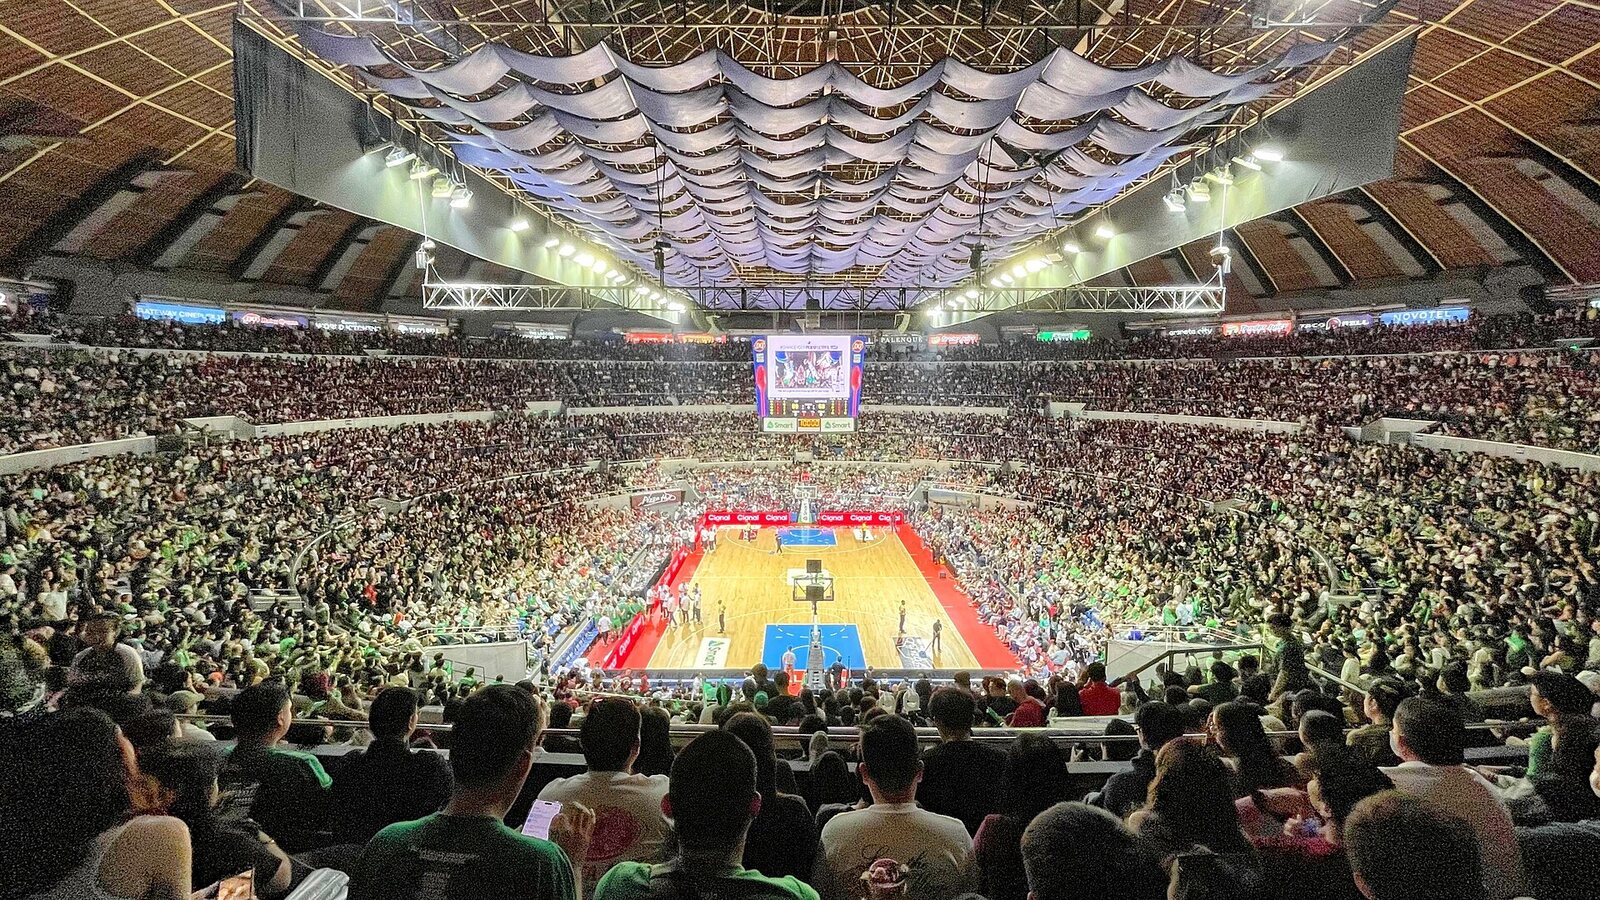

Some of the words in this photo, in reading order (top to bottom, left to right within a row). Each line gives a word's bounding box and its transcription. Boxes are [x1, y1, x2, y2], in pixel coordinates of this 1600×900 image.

[1393, 310, 1451, 322] NOVOTEL
[708, 514, 731, 522] Cignal
[737, 514, 759, 522] Cignal
[765, 514, 788, 522] Cignal
[821, 514, 844, 522] Cignal
[850, 514, 873, 522] Cignal
[703, 646, 721, 666] Smart
